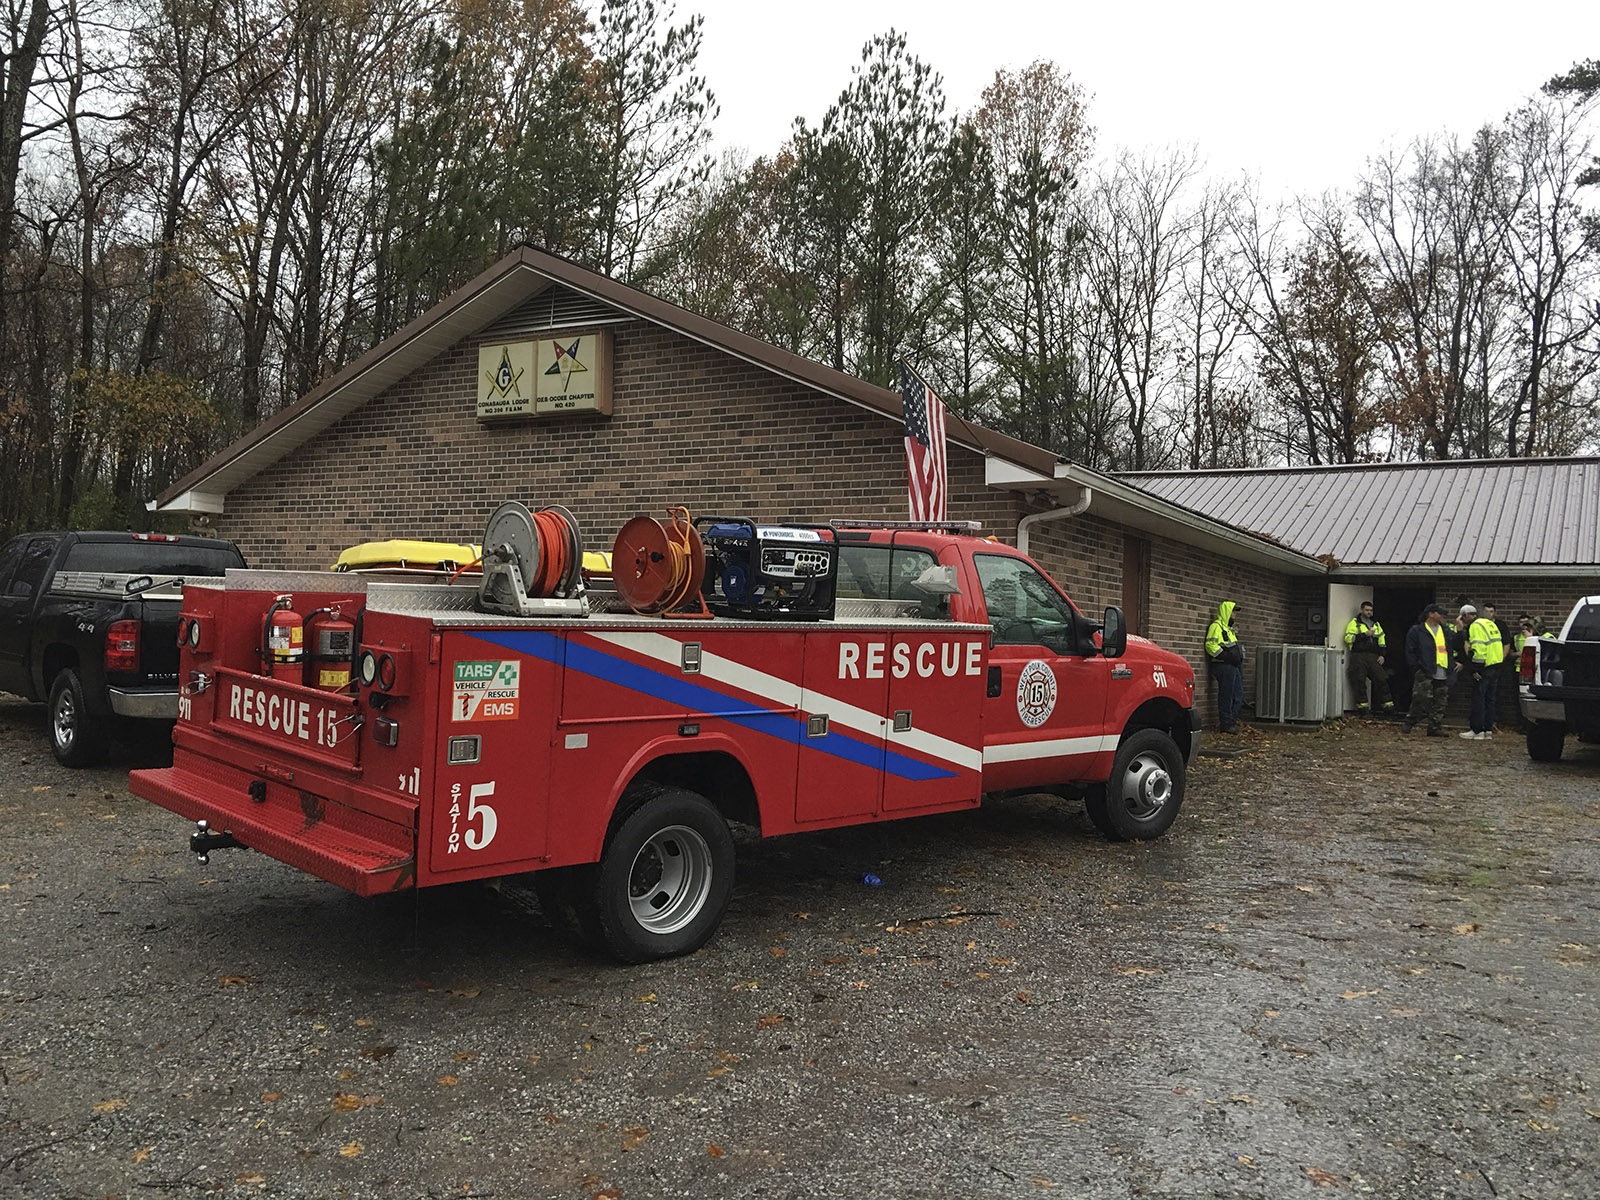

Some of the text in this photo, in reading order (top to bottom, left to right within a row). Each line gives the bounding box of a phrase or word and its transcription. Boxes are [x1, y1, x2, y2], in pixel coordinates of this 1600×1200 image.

[478, 400, 511, 408] CONASAUGA
[569, 393, 595, 401] CHAPTER
[838, 642, 983, 679] RESCUE
[457, 664, 493, 678] TARS
[1018, 668, 1029, 691] WEST
[1041, 664, 1057, 691] COUNTY
[1152, 671, 1167, 688] 911
[455, 681, 486, 690] VEHICLE
[487, 690, 516, 699] RESCUE
[1031, 684, 1043, 703] 15
[178, 696, 192, 721] 911
[229, 684, 338, 748] RESCUE 15
[483, 702, 515, 717] EMS
[447, 783, 461, 854] STATION
[464, 780, 498, 851] 5
